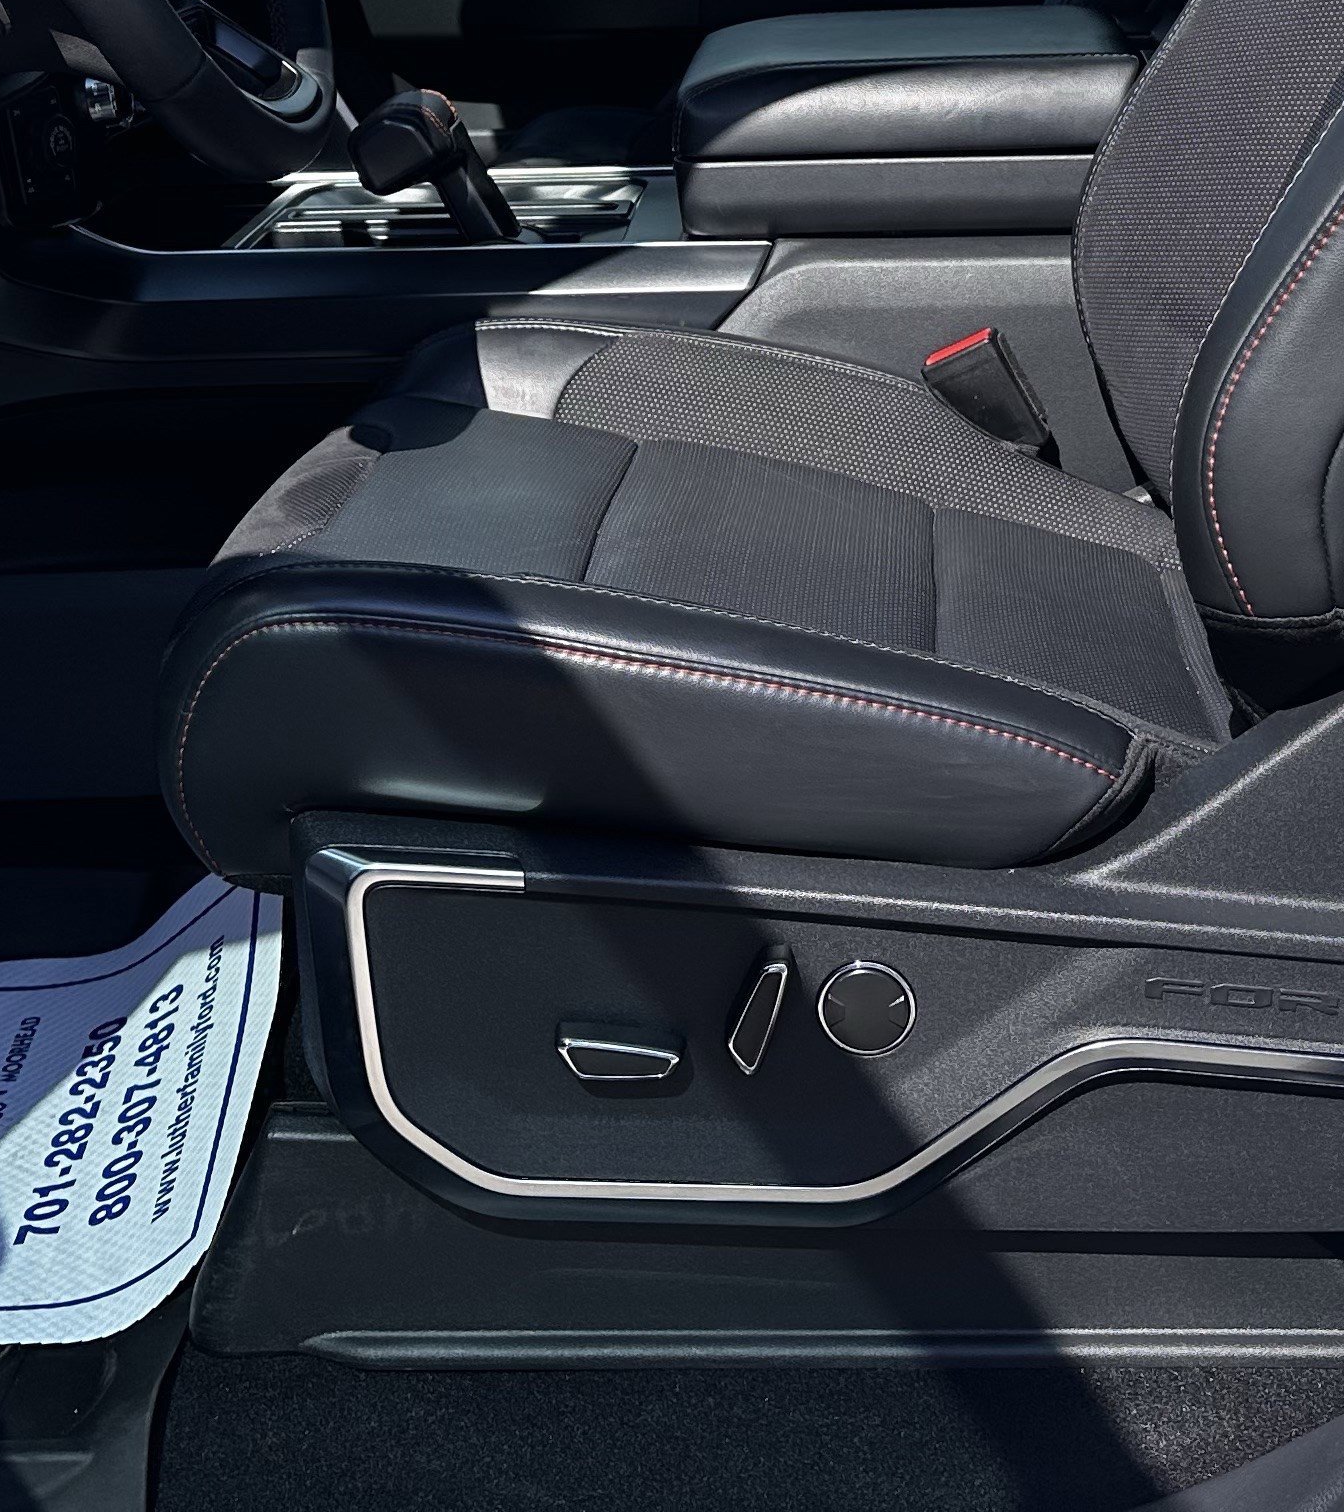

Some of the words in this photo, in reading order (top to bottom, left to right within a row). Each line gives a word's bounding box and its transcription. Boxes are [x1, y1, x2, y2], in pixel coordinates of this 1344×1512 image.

[1, 1016, 42, 1083] MOORHEAD
[12, 1015, 129, 1246] 701-282-2350
[87, 983, 185, 1227] 800-307-4813
[150, 934, 225, 1224] www.lutherfamilyford.com
